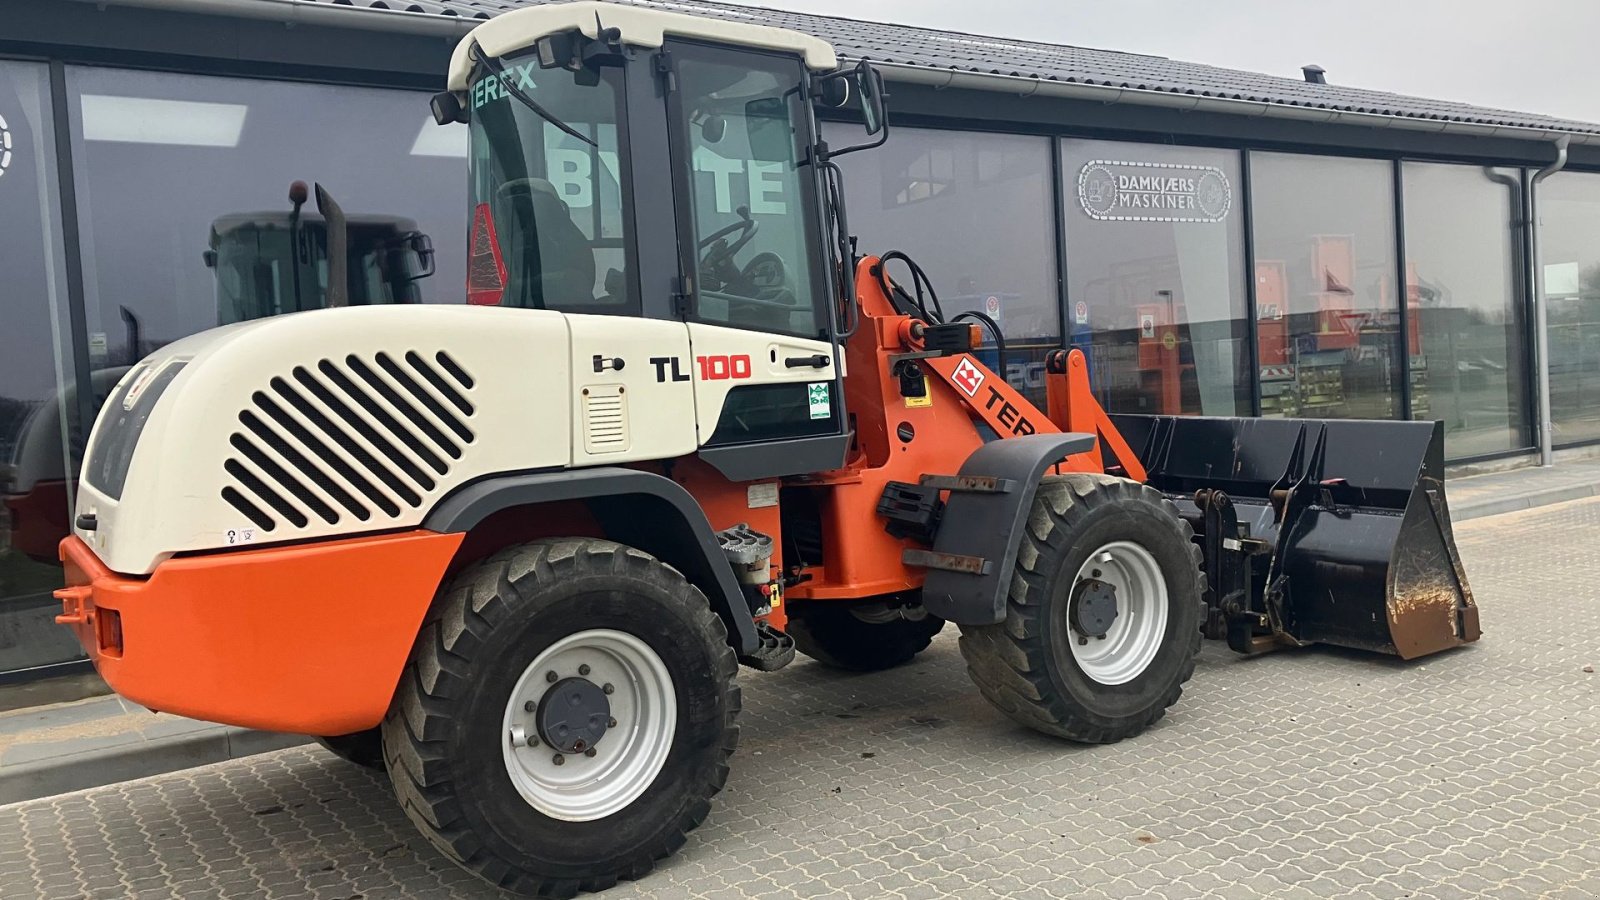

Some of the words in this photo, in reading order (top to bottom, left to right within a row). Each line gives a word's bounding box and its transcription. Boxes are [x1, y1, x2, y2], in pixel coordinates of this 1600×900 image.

[470, 61, 537, 112] TEREX
[1118, 175, 1195, 194] DAMKJÆRS
[1119, 193, 1195, 209] MASKINER
[649, 357, 690, 382] TL
[696, 354, 751, 381] 100
[985, 384, 1040, 436] TER
